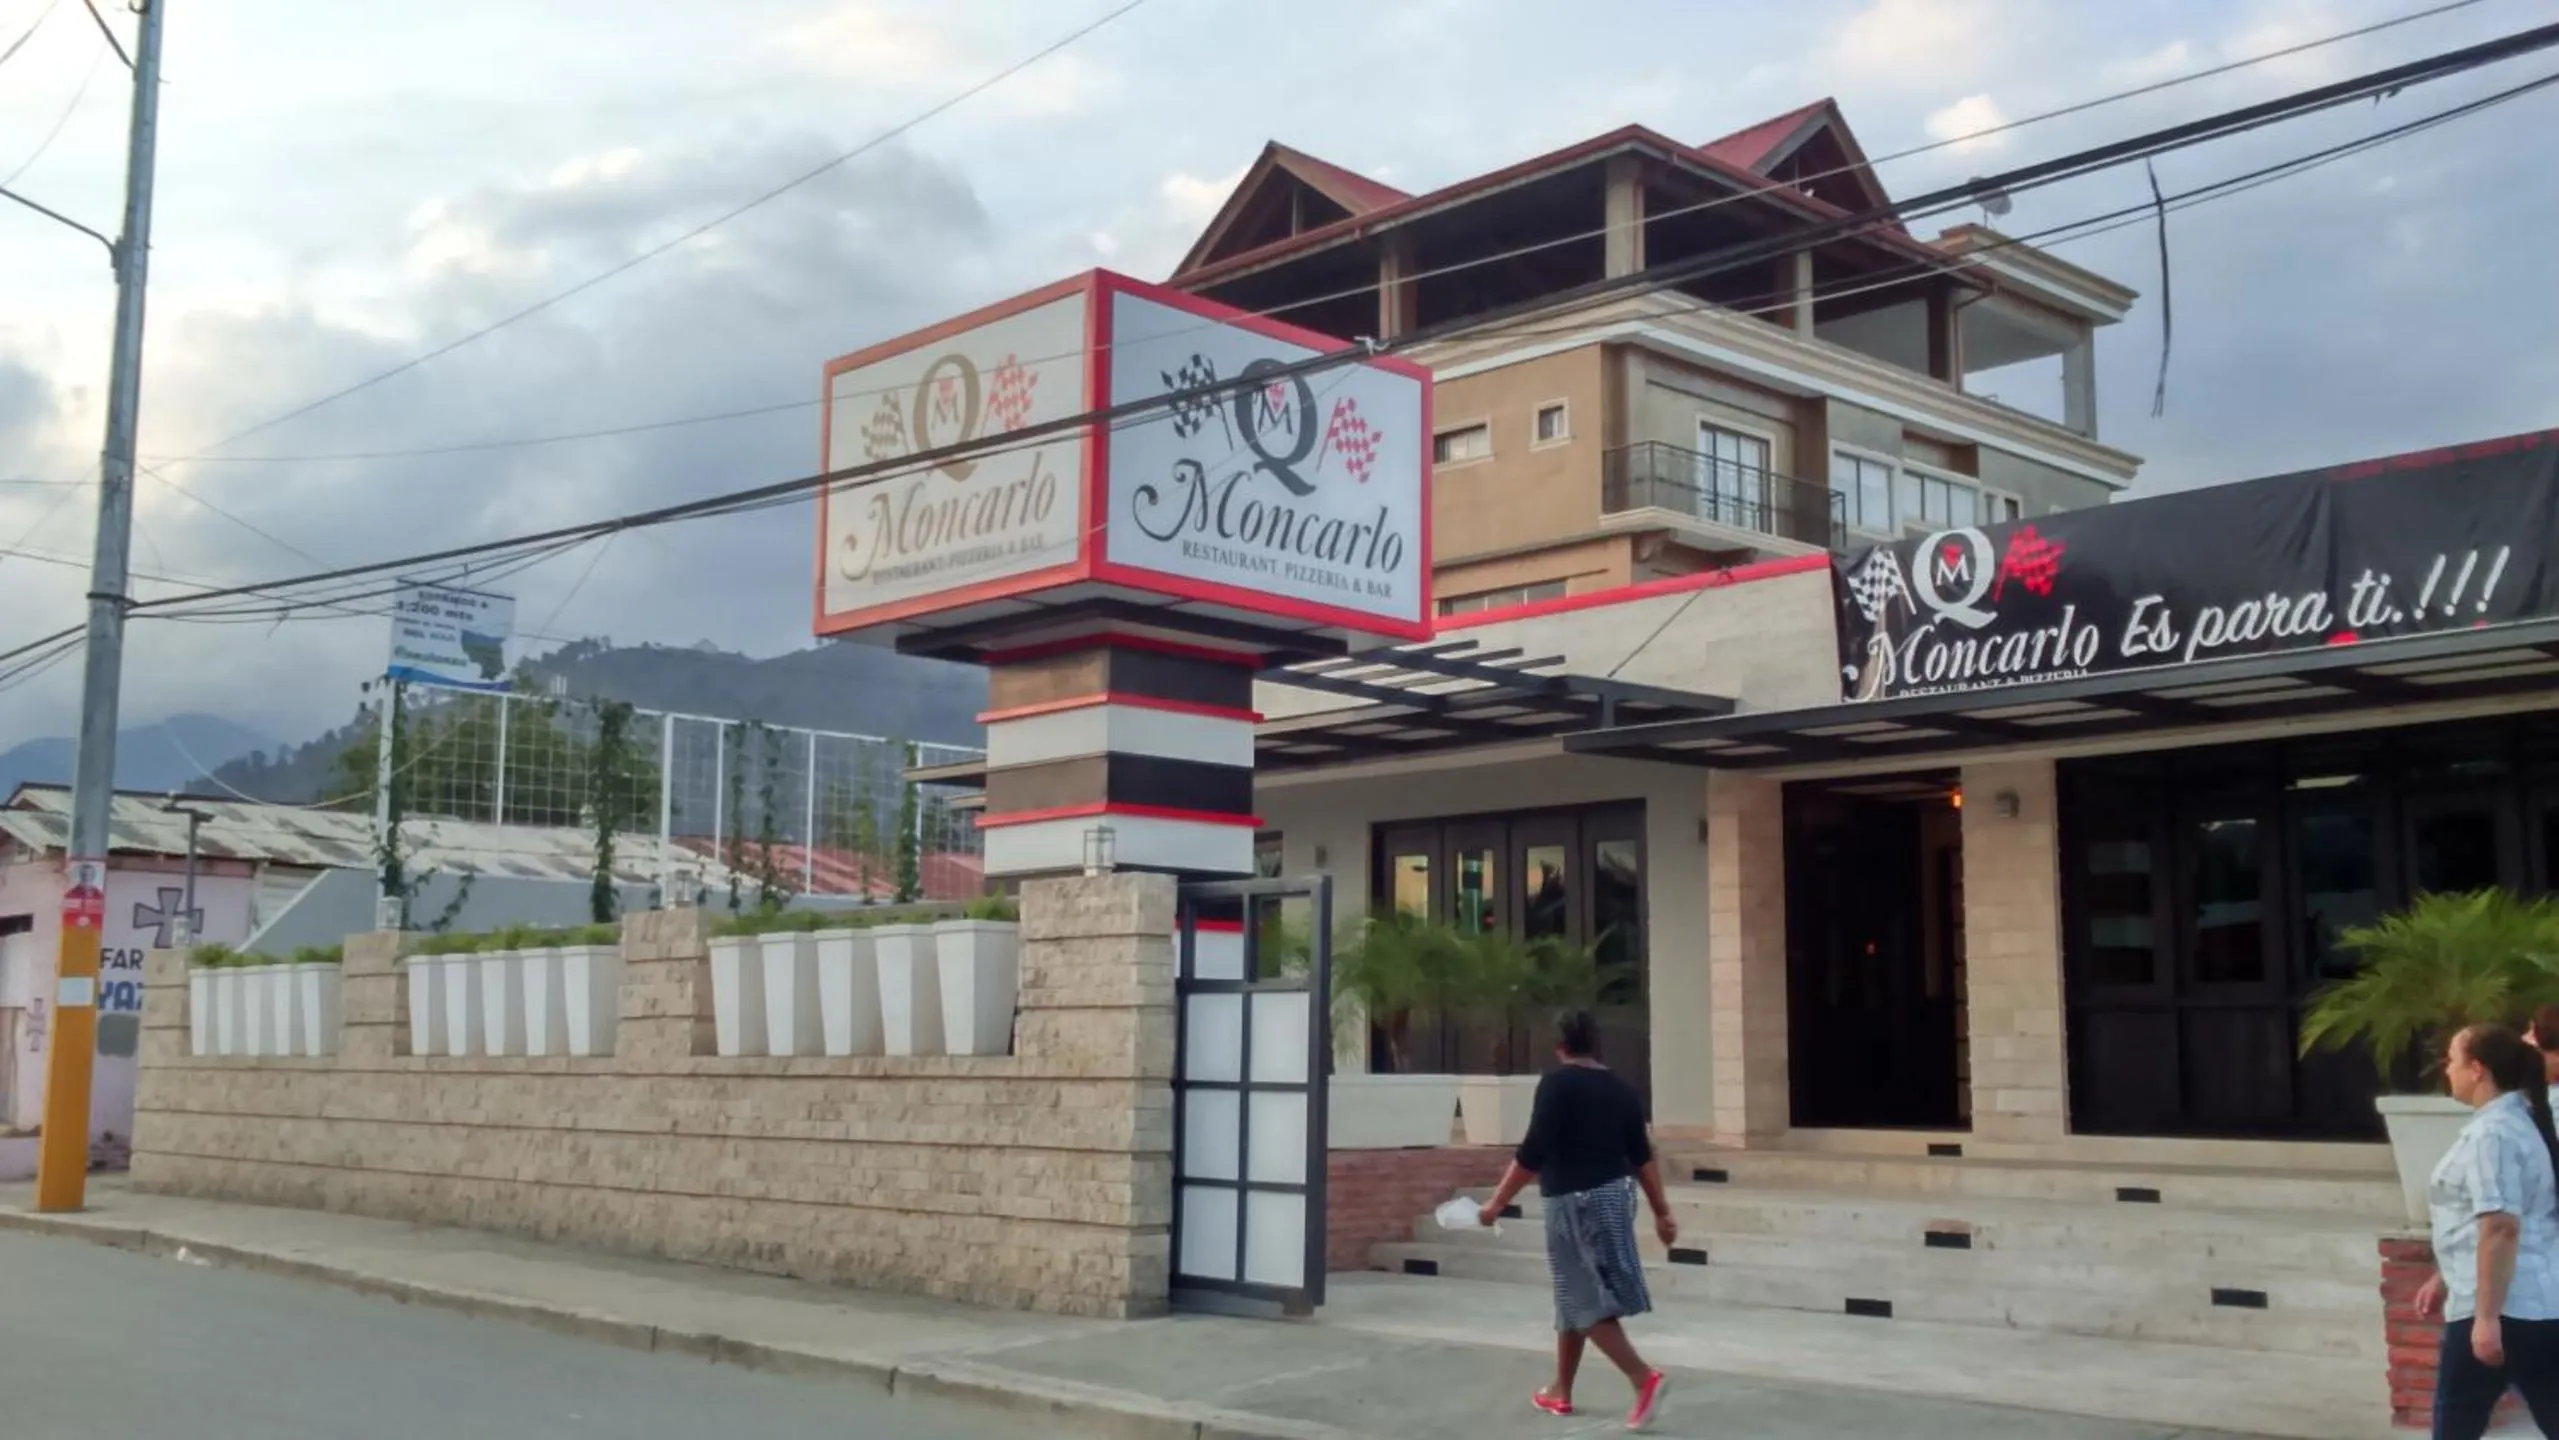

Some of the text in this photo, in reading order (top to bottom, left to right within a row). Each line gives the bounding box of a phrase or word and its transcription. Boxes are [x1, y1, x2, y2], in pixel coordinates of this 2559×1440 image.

[1233, 358, 1318, 497] Q
[839, 451, 1057, 581] Moncarlo
[1132, 457, 1404, 574] Moncarlo
[1182, 539, 1393, 599] RESTAURANT PIZZERIA & BAR
[1912, 526, 1999, 630] Q
[1936, 553, 1975, 586] M
[1842, 604, 2100, 704] Moncarlo
[2121, 593, 2180, 657] Es
[2185, 591, 2333, 663] para
